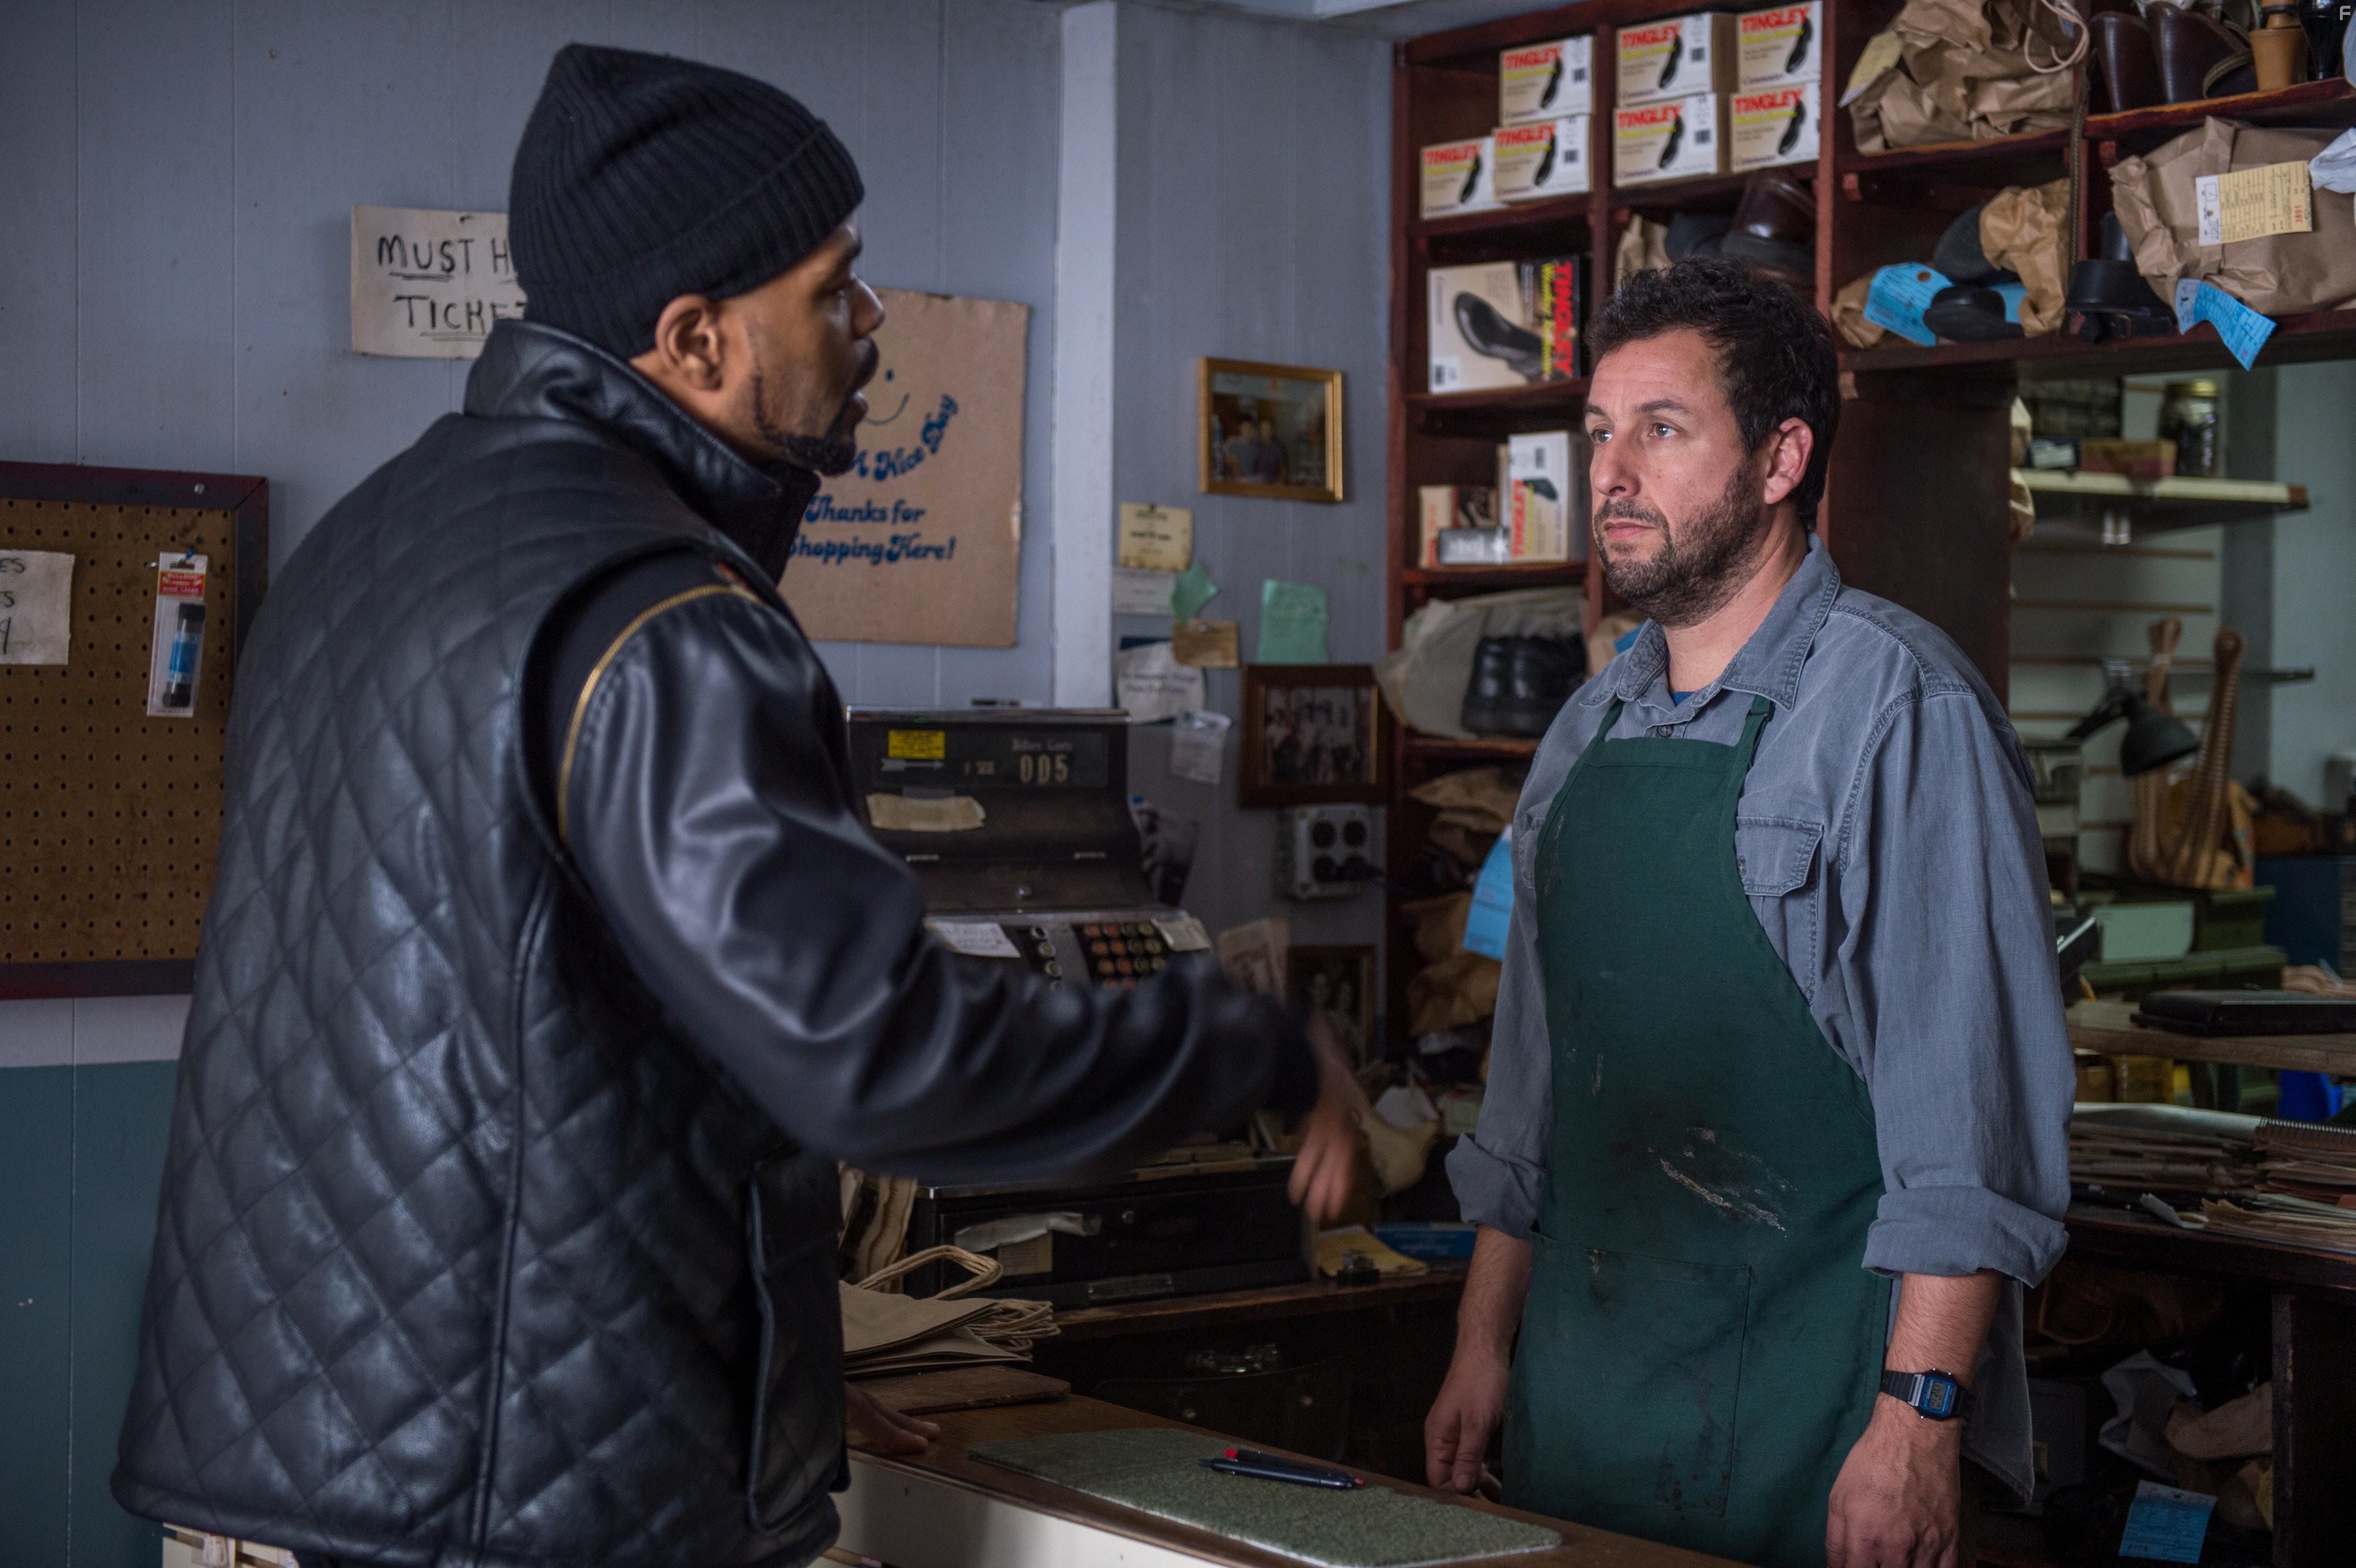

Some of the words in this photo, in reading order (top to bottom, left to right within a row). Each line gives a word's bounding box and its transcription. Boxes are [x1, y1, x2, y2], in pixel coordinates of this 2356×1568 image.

[1741, 6, 1810, 33] TINGLEY
[1620, 24, 1681, 49] TINGLEY
[1734, 89, 1803, 114] TINGLEY
[1616, 105, 1681, 129] TINGLEY
[377, 234, 475, 273] MUST
[393, 294, 528, 335] TICKE
[1552, 261, 1574, 377] TINGLEY
[874, 446, 925, 482] Nice
[921, 393, 959, 455] Day
[805, 494, 886, 522] Thanks
[891, 498, 925, 524] for
[886, 533, 956, 563] Here!
[1018, 754, 1069, 786] 005
